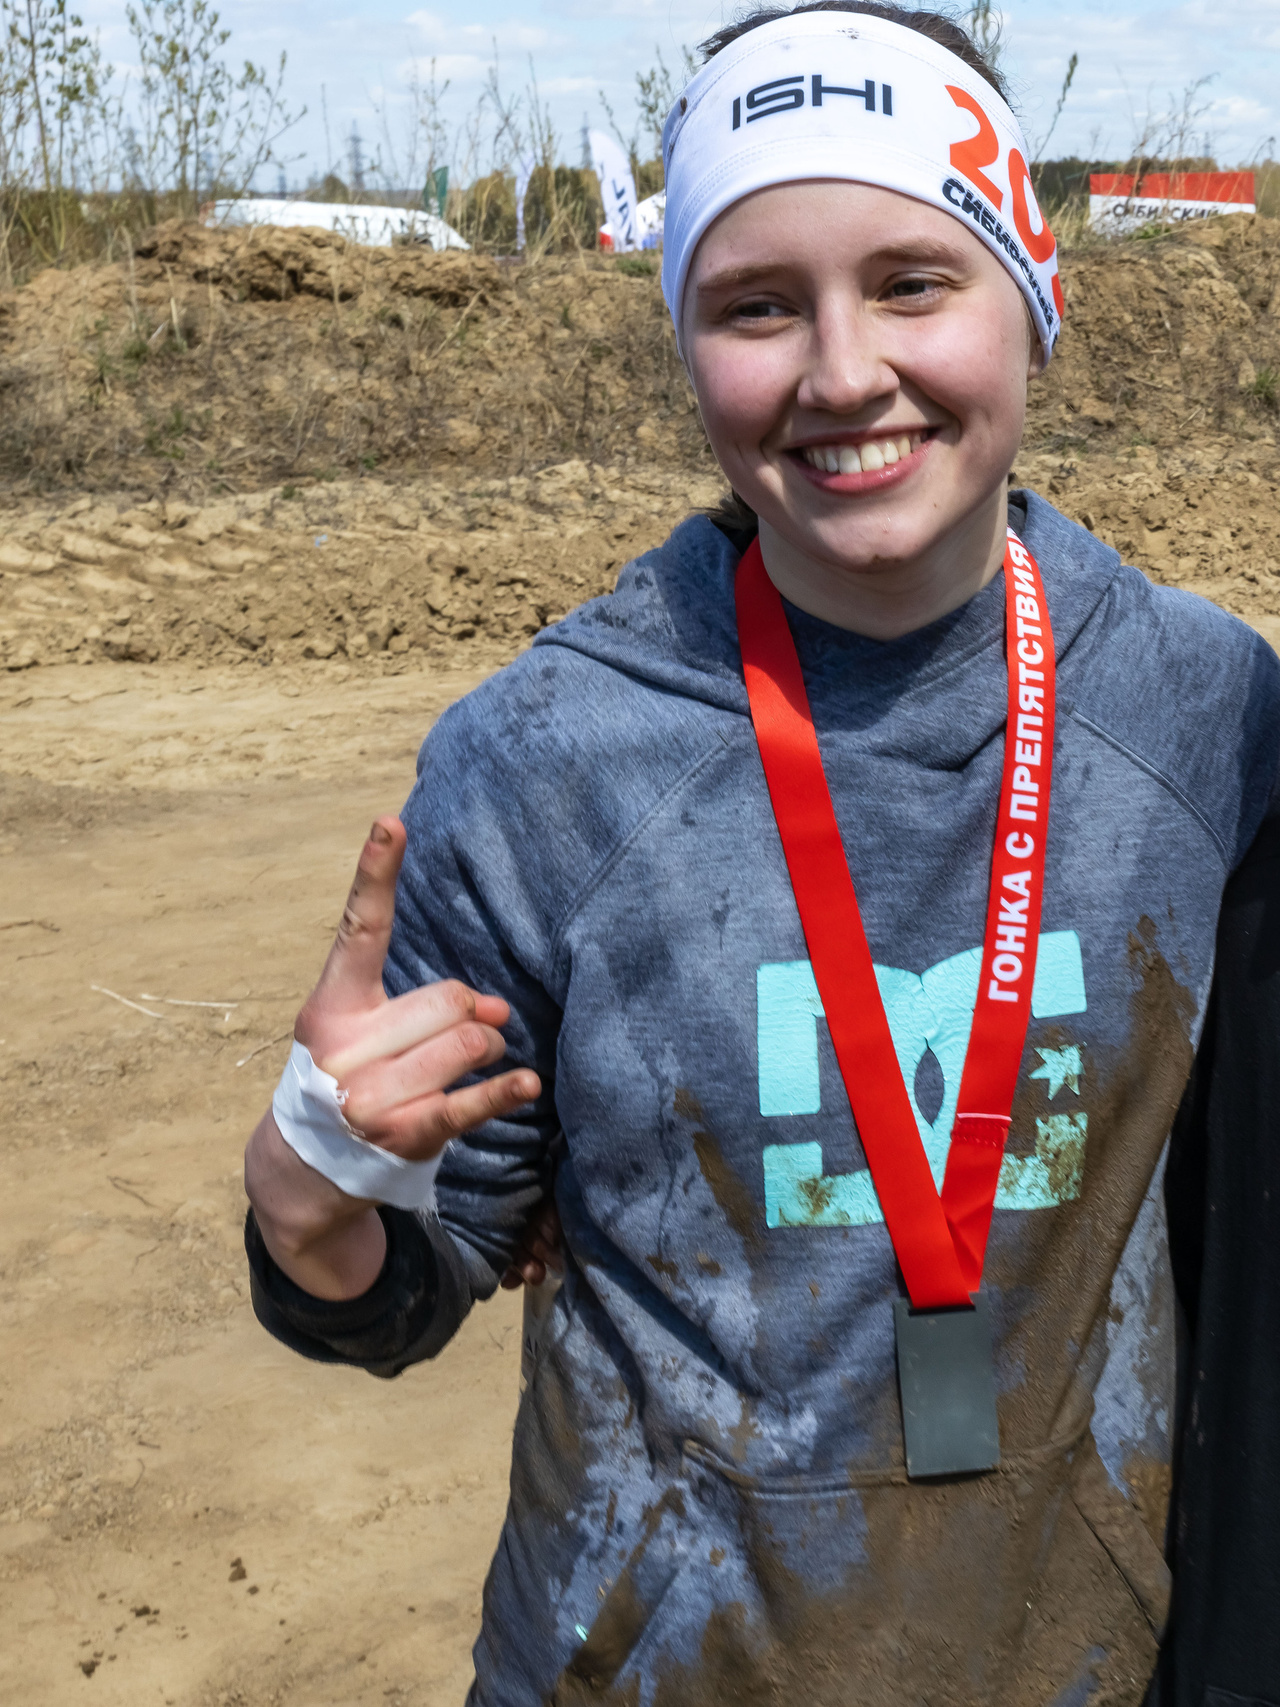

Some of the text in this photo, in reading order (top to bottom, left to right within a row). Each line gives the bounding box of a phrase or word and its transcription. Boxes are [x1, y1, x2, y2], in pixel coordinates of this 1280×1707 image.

[732, 74, 893, 131] ISHI
[1005, 831, 1035, 859] С
[988, 870, 1032, 1002] ГОНКА
